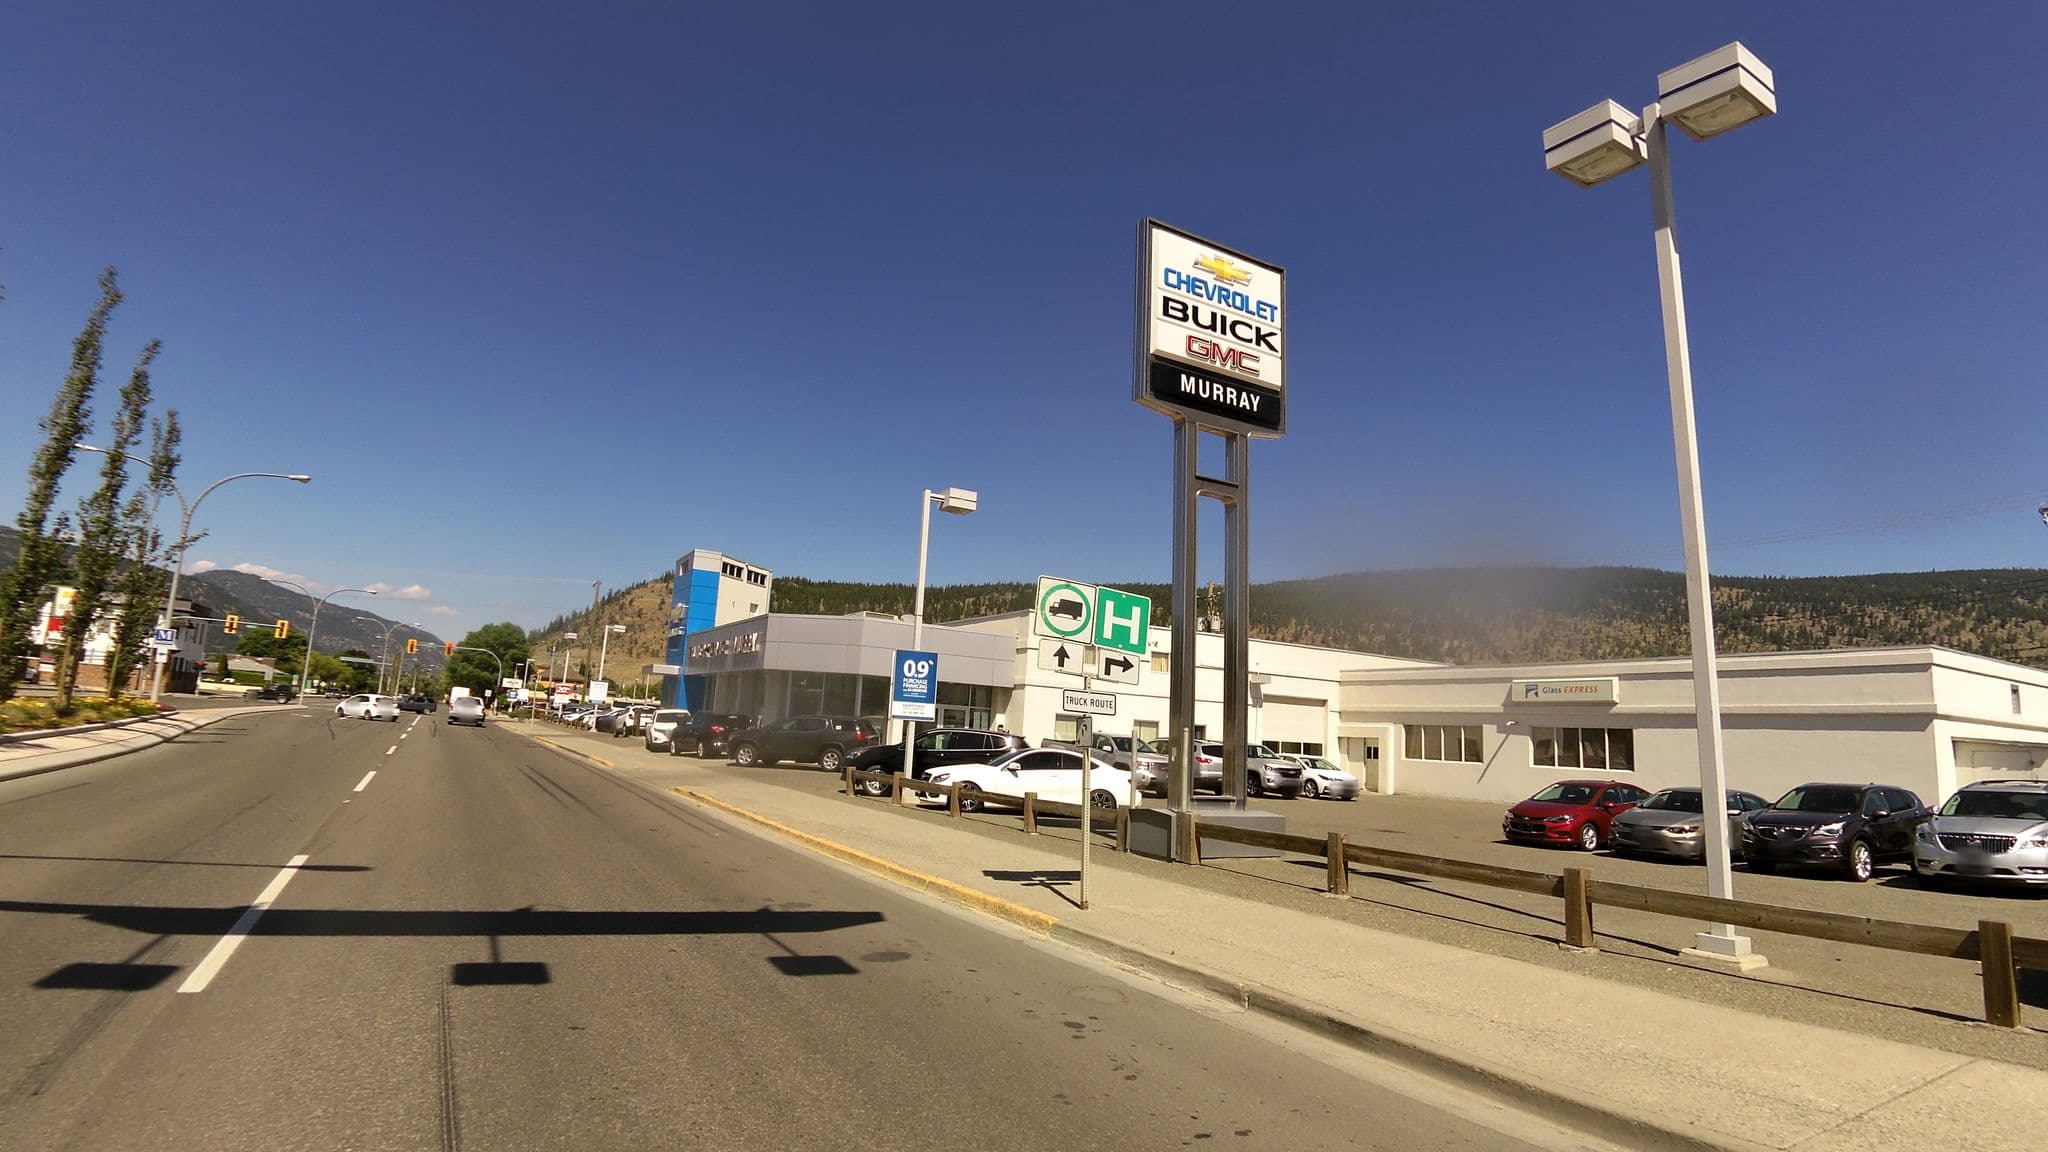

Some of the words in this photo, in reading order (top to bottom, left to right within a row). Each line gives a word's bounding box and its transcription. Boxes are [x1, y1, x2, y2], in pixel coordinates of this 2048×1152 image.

[1163, 267, 1278, 323] CHEVROLET
[1162, 295, 1279, 353] BUICK
[1186, 334, 1261, 377] GMC
[1180, 374, 1260, 412] MURRAY
[1103, 599, 1141, 645] H
[1066, 696, 1088, 707] TRUCK
[1090, 698, 1113, 709] ROUTE
[1542, 686, 1562, 694] Glass
[1563, 685, 1599, 693] EXPRESS
